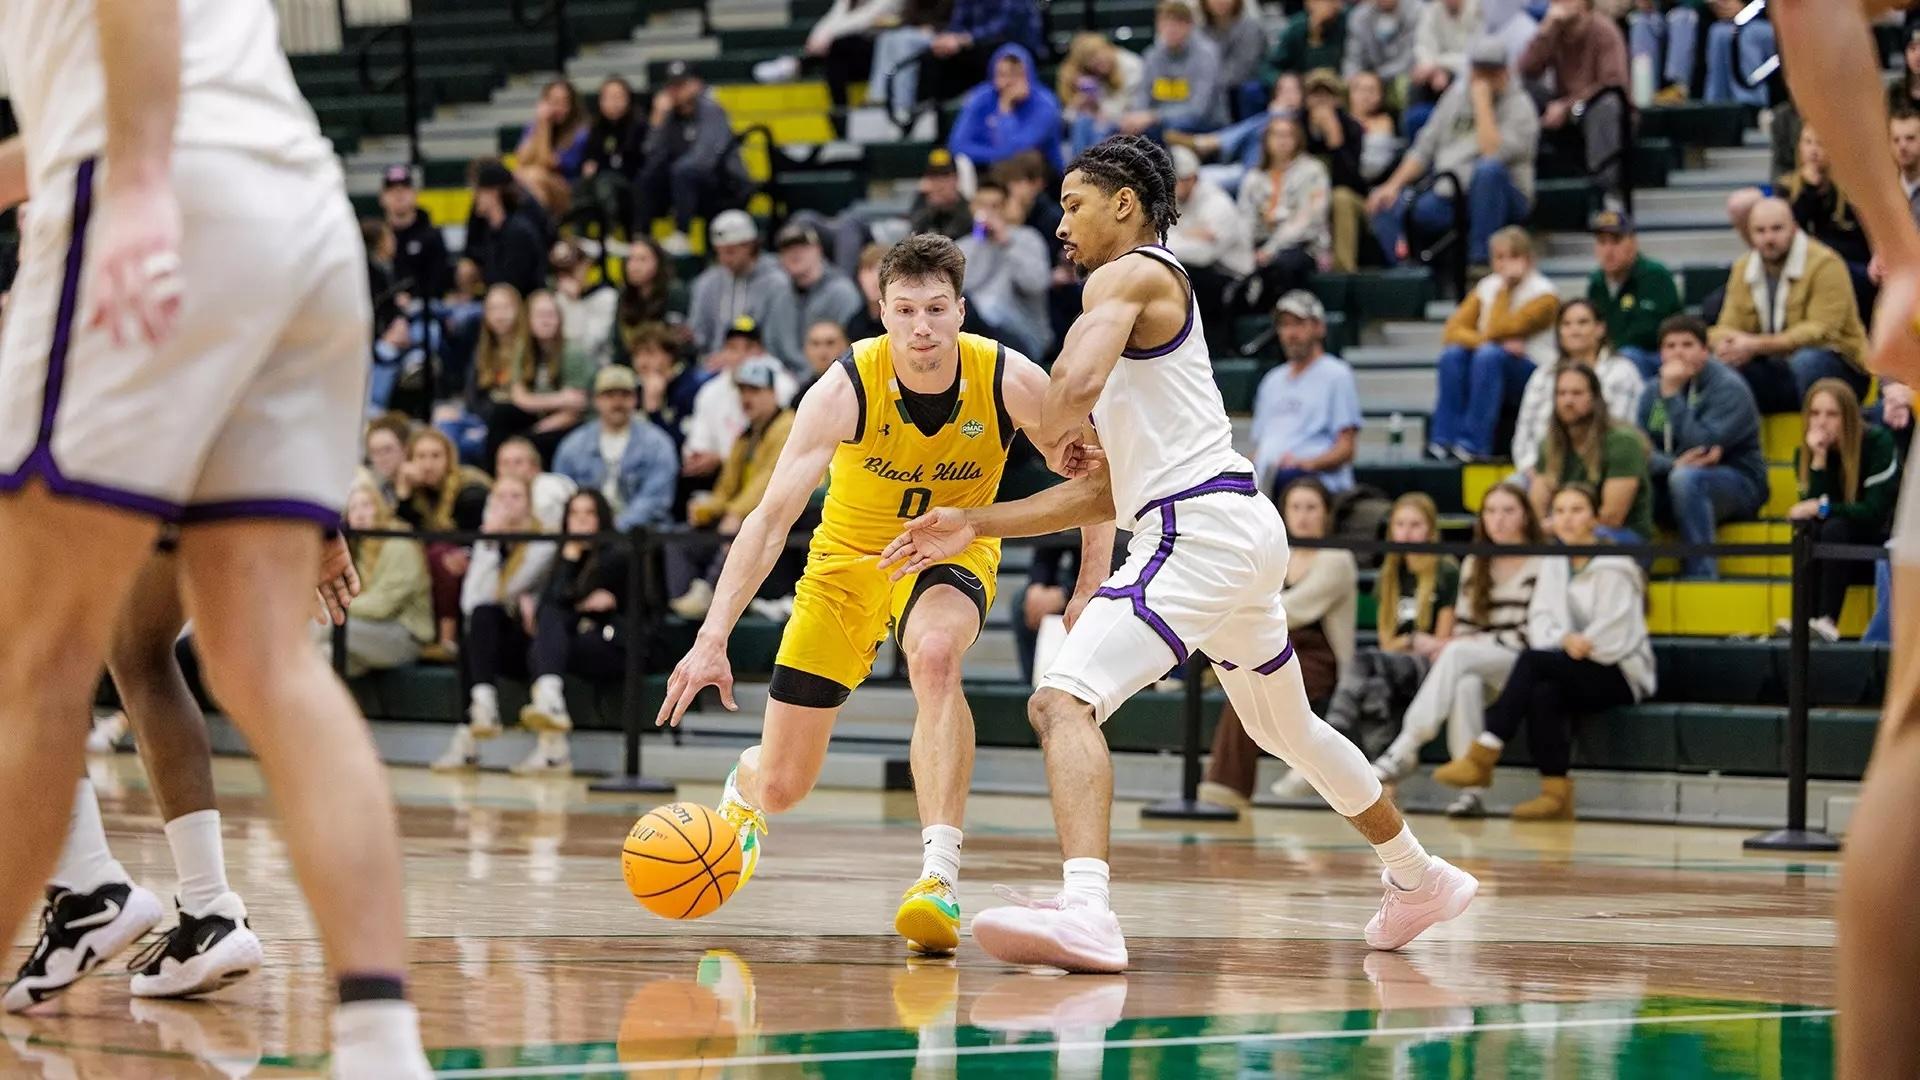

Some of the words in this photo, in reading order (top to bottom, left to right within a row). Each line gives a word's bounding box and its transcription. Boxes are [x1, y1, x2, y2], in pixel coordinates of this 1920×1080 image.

[863, 457, 923, 483] Black
[931, 461, 983, 482] Hills
[897, 488, 932, 519] 0
